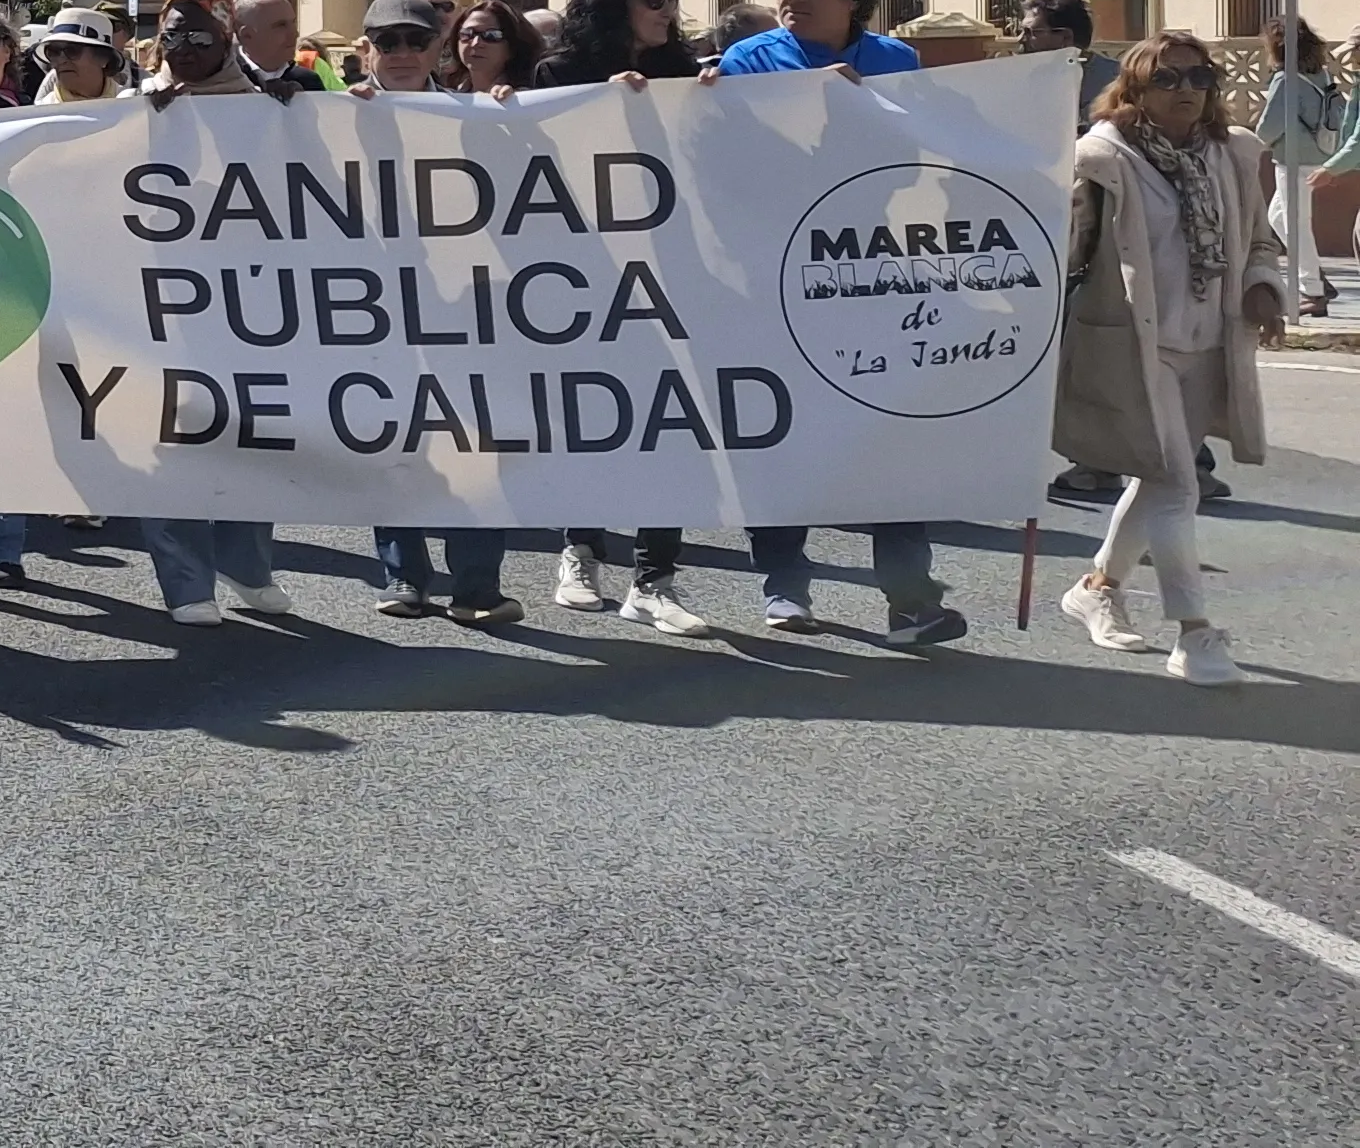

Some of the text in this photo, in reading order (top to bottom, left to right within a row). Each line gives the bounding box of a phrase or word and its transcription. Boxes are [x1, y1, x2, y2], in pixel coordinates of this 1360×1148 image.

[122, 152, 677, 243] SANIDAD
[810, 218, 1019, 262] MAREA
[140, 260, 690, 347] PÚBLICA
[801, 253, 1042, 300] BLANCA
[901, 299, 943, 332] de
[57, 362, 794, 455] Y DE CALIDAD
